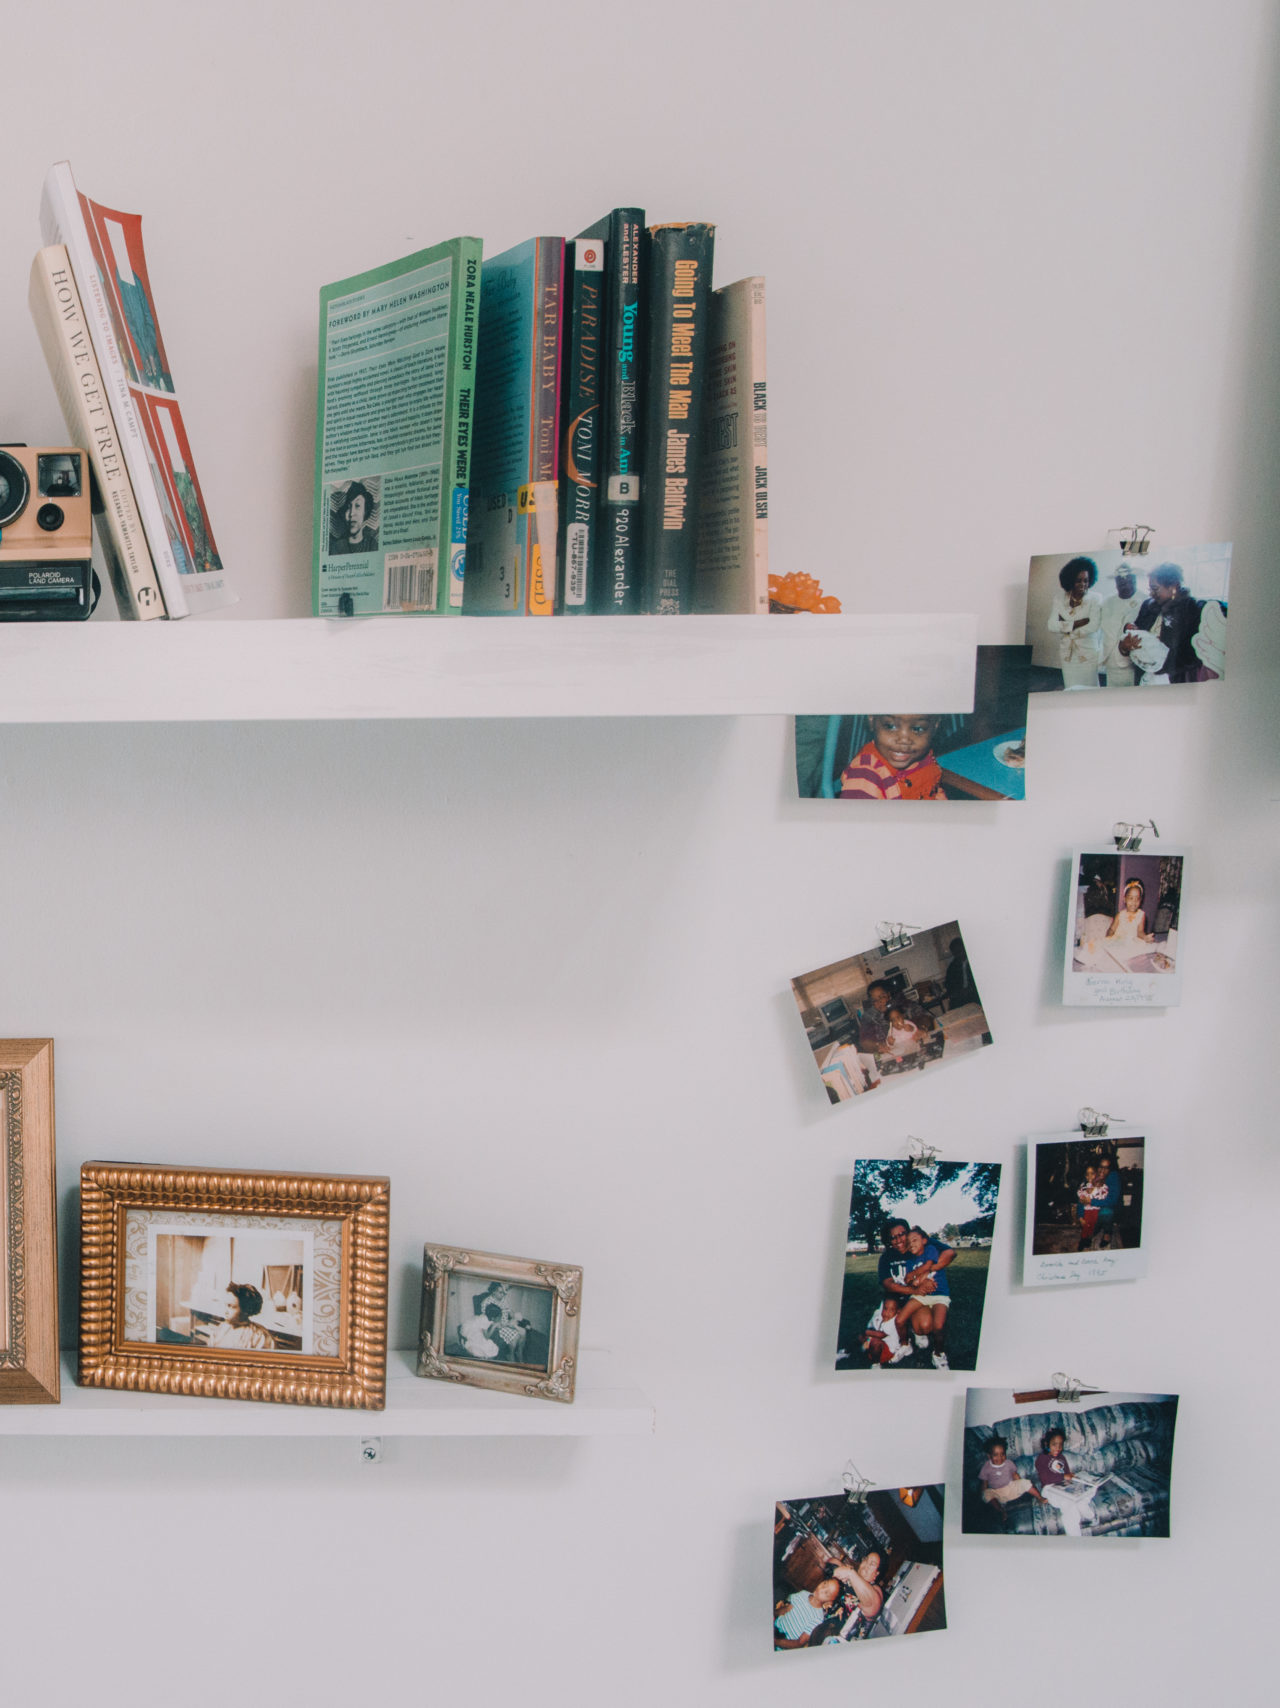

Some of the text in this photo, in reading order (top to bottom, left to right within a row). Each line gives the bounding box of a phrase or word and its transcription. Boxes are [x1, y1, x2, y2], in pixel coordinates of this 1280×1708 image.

[622, 244, 630, 284] LESTER
[631, 223, 640, 285] ALEXANDER
[89, 274, 105, 319] LISTENING
[328, 281, 450, 329] FOREWORD BY MARY HELEN WASHINGTON
[462, 259, 477, 371] ZORA NEALE HURSTON
[543, 283, 558, 325] TAR
[102, 321, 109, 332] TO
[579, 283, 598, 401] PARADISE
[618, 300, 638, 363] Young
[105, 334, 118, 365] IMAGES
[542, 335, 557, 393] BABY
[51, 269, 121, 481] HOW WE GET FREE
[118, 378, 127, 398] TINA
[621, 363, 629, 380] and
[458, 388, 471, 418] THEIR
[620, 380, 636, 435] Black
[663, 259, 698, 530] Going To Meet The Man James Baldwin
[753, 382, 767, 411] BLACK
[126, 411, 139, 438] CAMPT
[456, 421, 470, 446] EYES
[540, 416, 556, 454] Toni
[576, 415, 593, 460] TONI
[619, 436, 627, 446] in
[456, 449, 468, 480] WERE
[619, 482, 630, 495] B
[754, 466, 768, 520] JACK OLSEN
[128, 551, 140, 575] TAYLOR
[614, 509, 629, 606] 920 Alexander
[664, 569, 677, 578] THE
[660, 588, 679, 596] PRESS
[663, 579, 677, 587] DIAL
